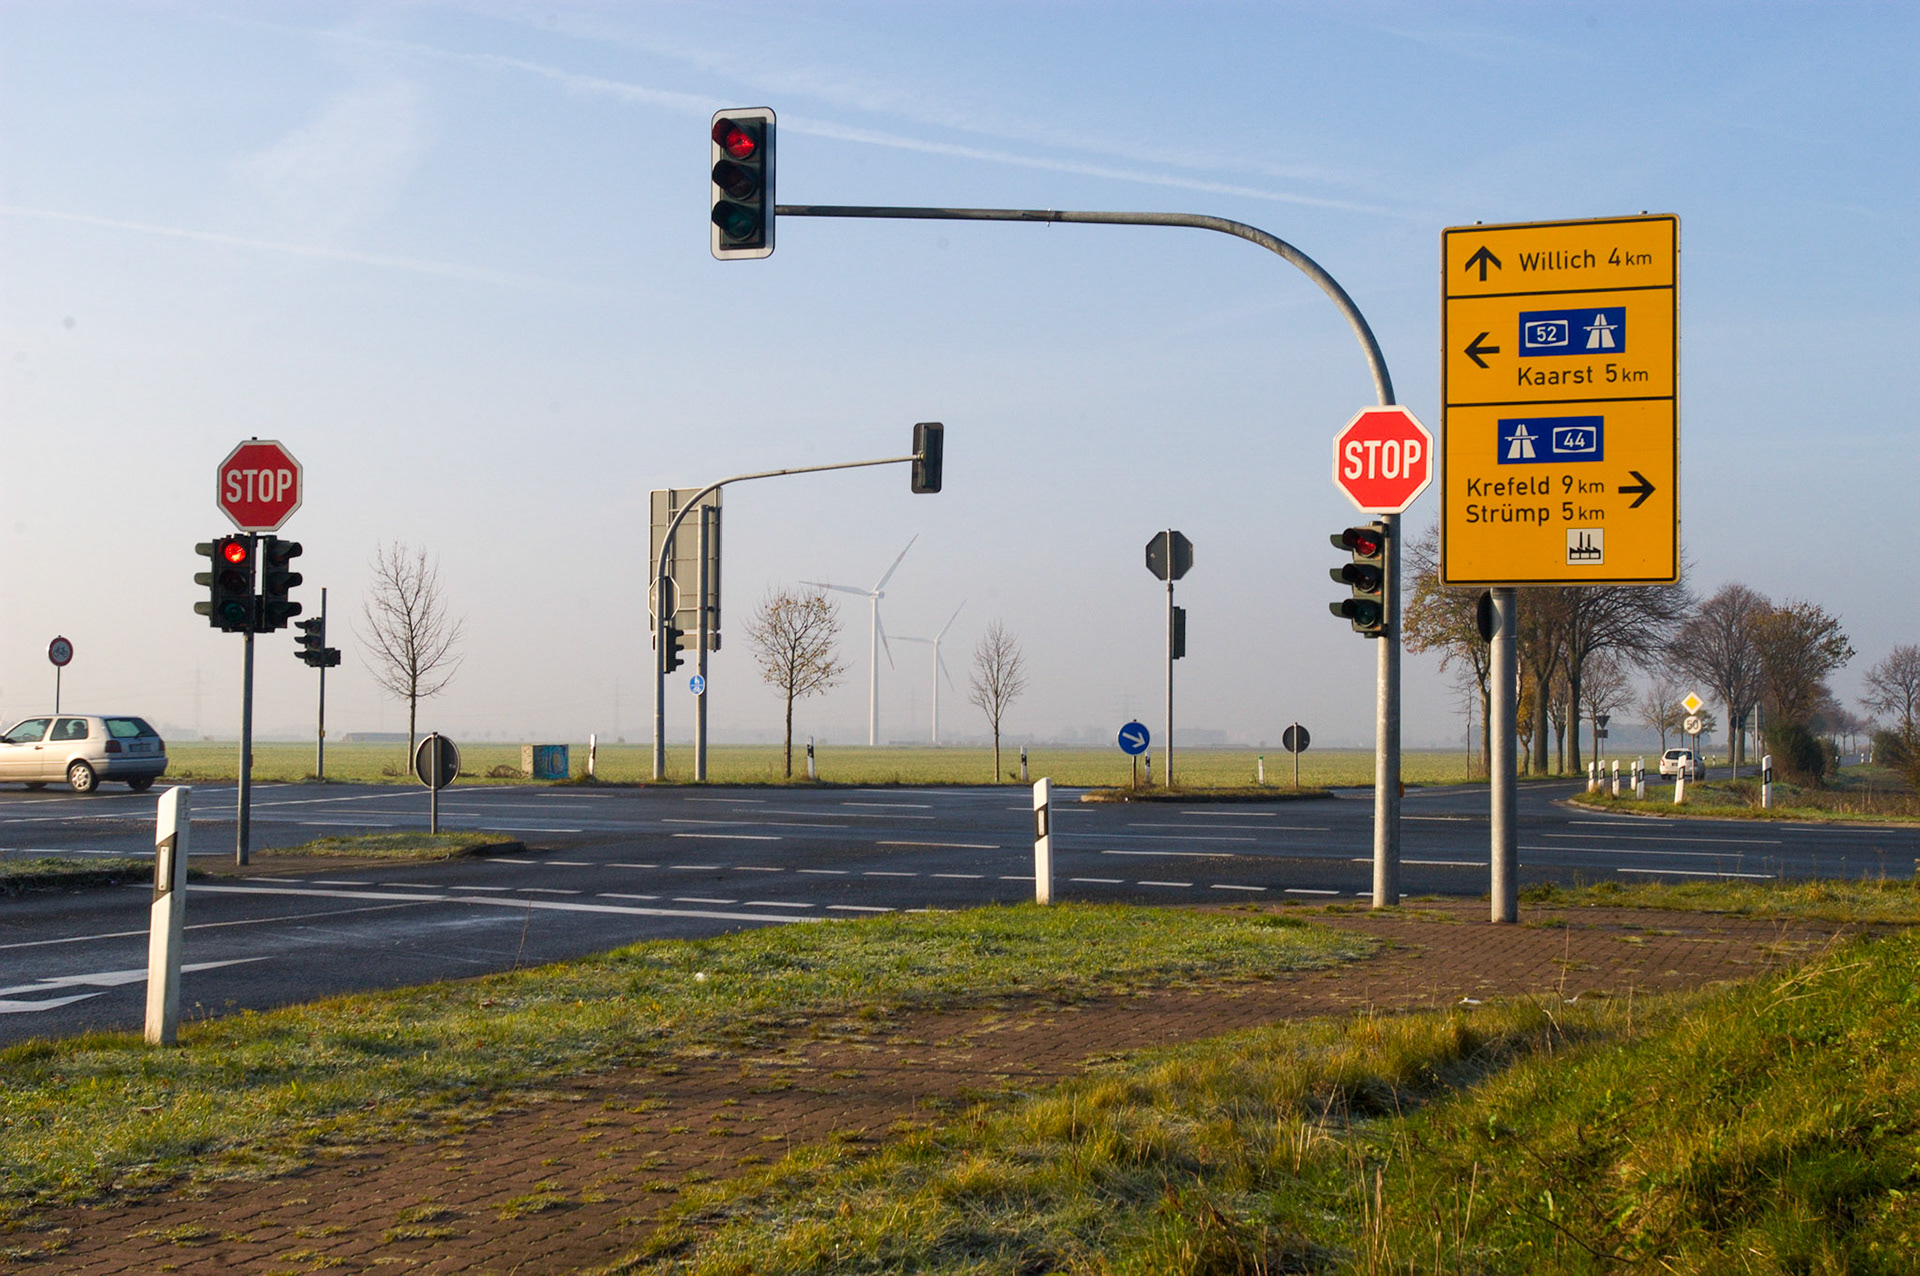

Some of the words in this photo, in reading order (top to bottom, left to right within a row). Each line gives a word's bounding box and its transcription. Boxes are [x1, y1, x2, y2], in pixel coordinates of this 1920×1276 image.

[1519, 250, 1596, 272] Willich
[1537, 326, 1557, 342] 52
[1518, 366, 1593, 386] Kaarst
[1564, 432, 1585, 447] 44
[1344, 439, 1421, 480] STOP
[226, 469, 292, 503] STOP
[1467, 476, 1550, 497] Krefeld
[1466, 504, 1550, 526] Strümp
[1687, 719, 1699, 730] 50
